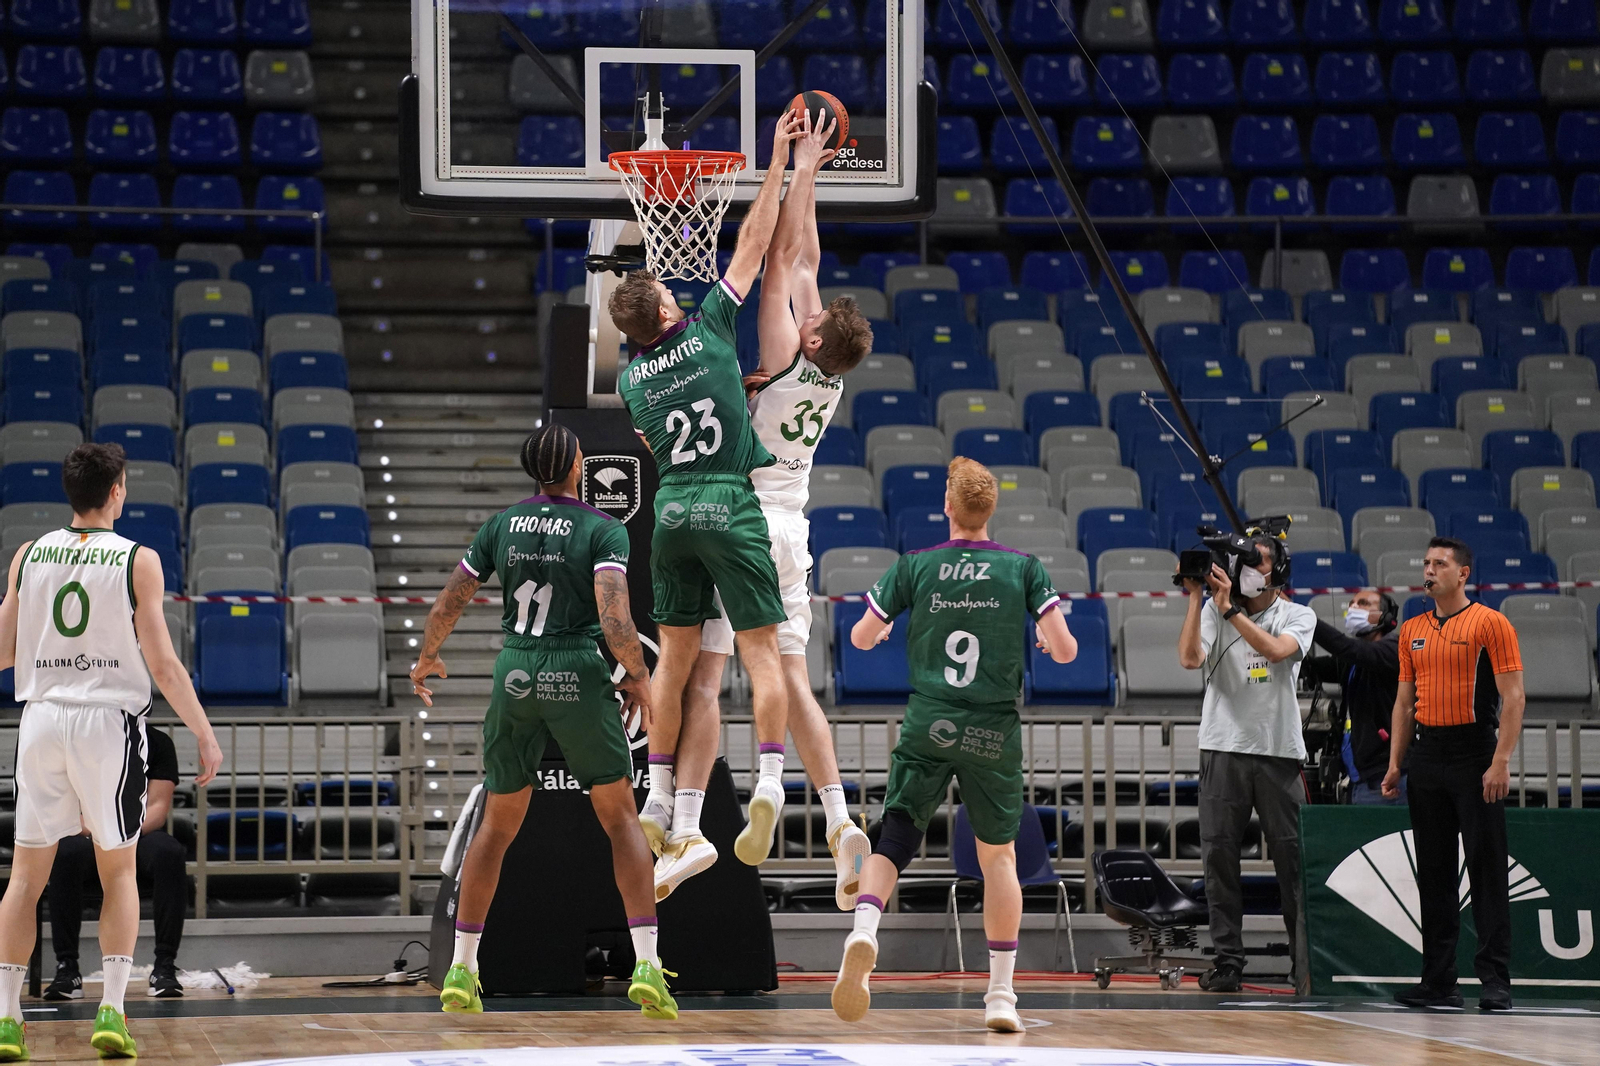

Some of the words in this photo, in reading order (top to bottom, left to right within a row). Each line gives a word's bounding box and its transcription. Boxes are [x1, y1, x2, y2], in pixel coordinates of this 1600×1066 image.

[832, 157, 883, 169] endesa
[628, 336, 704, 388] ABROMAITIS
[665, 397, 723, 465] 23
[780, 399, 830, 447] 35
[594, 491, 628, 502] Unicaja
[690, 502, 730, 514] COSTA
[690, 513, 707, 522] DEL
[709, 514, 730, 523] SOL
[508, 516, 573, 537] THOMAS
[690, 521, 730, 532] MÁLAGA
[938, 558, 991, 581] DÍAZ
[53, 581, 90, 637] 0
[513, 579, 553, 637] 11
[36, 659, 72, 668] DALONA
[92, 659, 119, 668] FUTUR
[944, 630, 980, 688] 9
[536, 671, 580, 683] COSTA
[536, 684, 558, 693] DEL
[559, 684, 580, 693] SOL
[536, 691, 580, 702] MÁLAGA
[964, 726, 1004, 742] COSTA
[962, 736, 983, 748] DEL
[985, 740, 1003, 752] SOL
[1538, 909, 1594, 960] U
